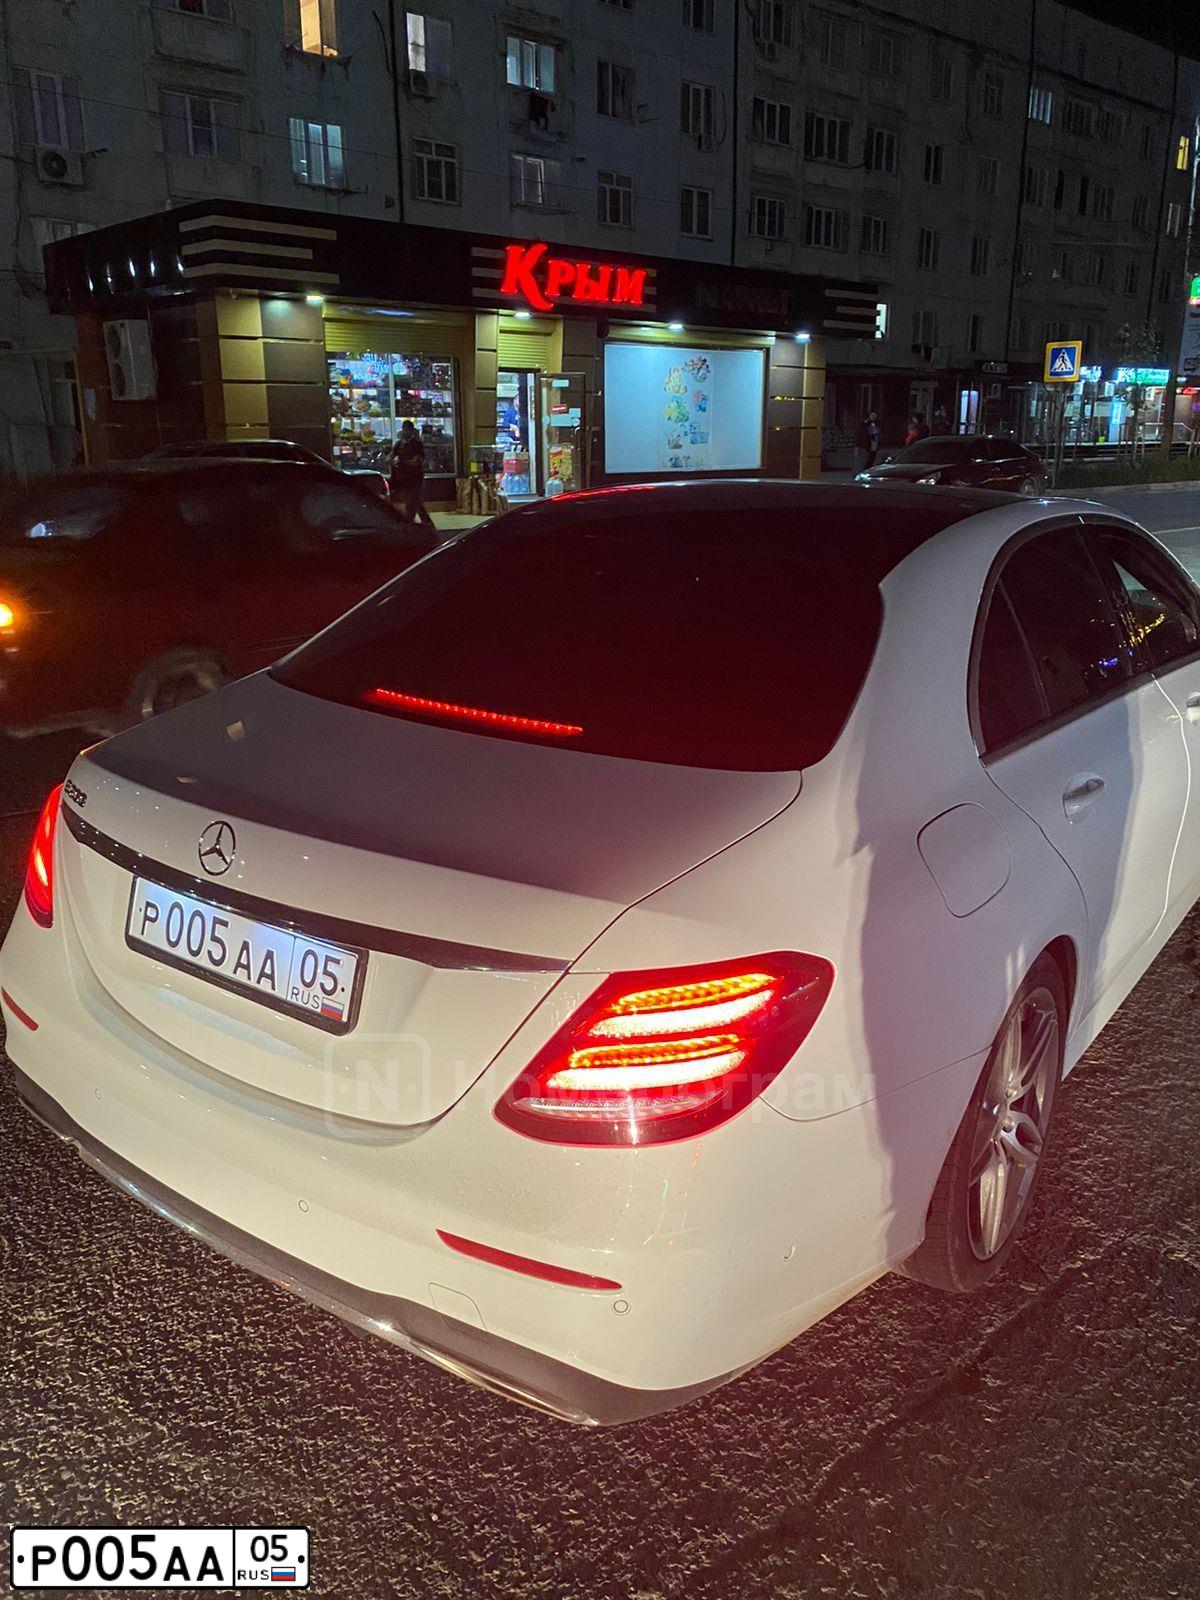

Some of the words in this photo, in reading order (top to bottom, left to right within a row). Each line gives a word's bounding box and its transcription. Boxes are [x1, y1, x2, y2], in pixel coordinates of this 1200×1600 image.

[141, 901, 277, 991] Р005АА
[299, 948, 342, 997] 05
[291, 986, 320, 1010] RUS
